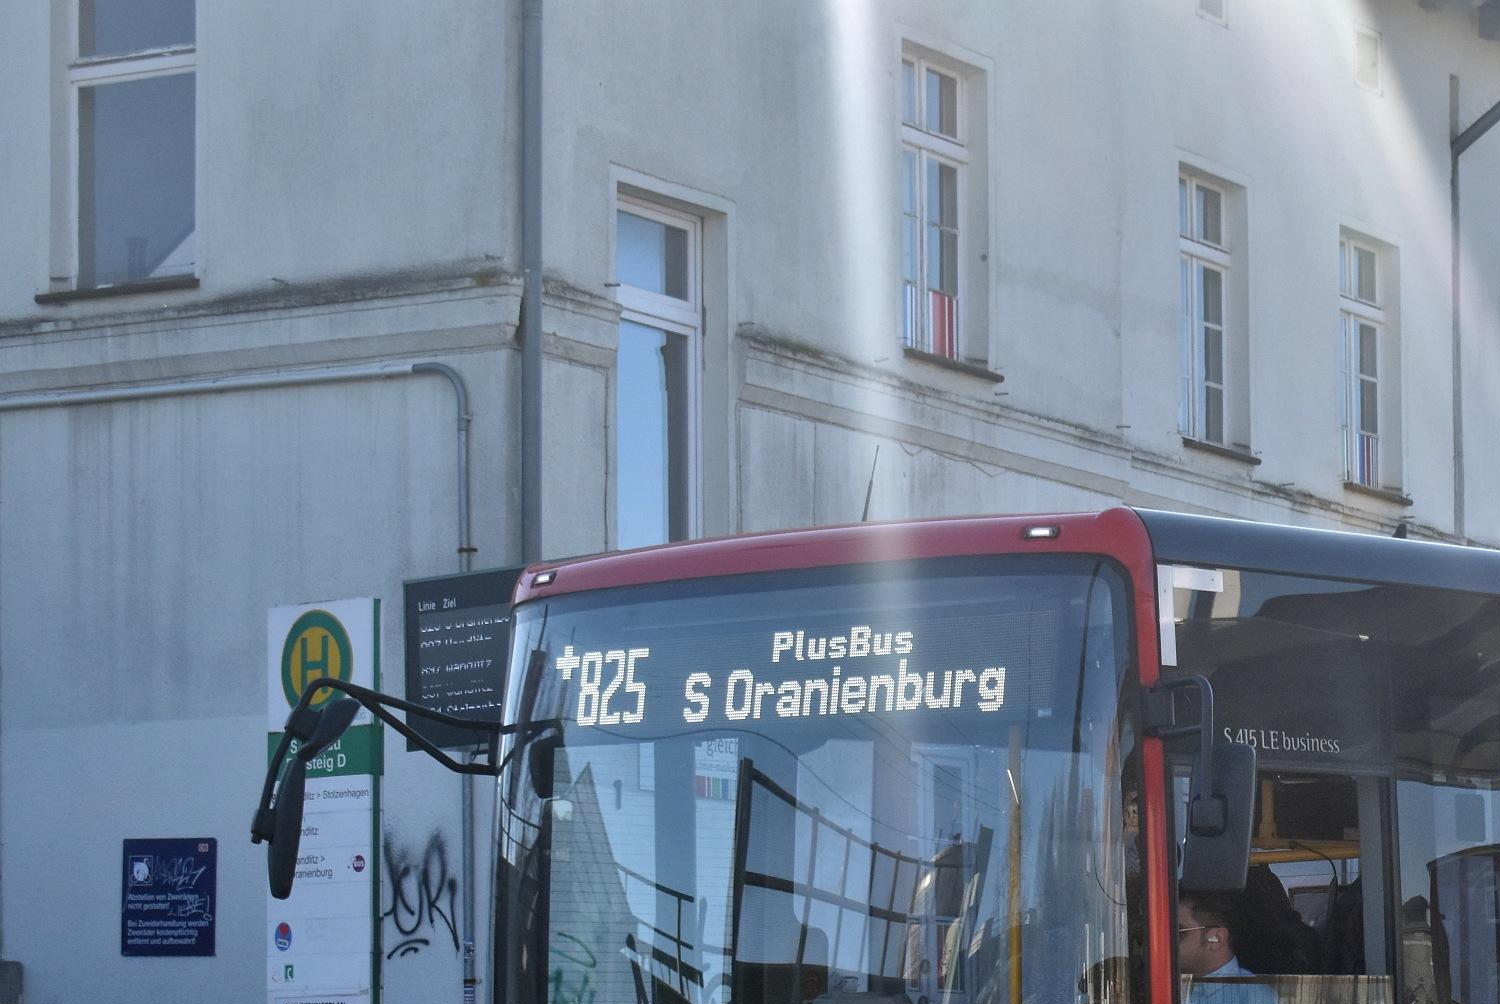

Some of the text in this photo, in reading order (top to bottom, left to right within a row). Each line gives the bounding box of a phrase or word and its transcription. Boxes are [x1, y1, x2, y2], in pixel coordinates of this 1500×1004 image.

[418, 598, 457, 611] Linie Ziel
[772, 626, 913, 662] PlusBus
[301, 635, 328, 694] H
[683, 672, 712, 723] S
[725, 659, 1006, 721] Oranienburg
[1235, 729, 1257, 748] 415
[1260, 729, 1279, 750] LE
[1282, 731, 1340, 754] business
[337, 754, 346, 768] D
[323, 788, 369, 800] Stolzenhagen
[296, 856, 319, 866] andlitz
[128, 902, 142, 910] nicht
[128, 919, 138, 927] Bei
